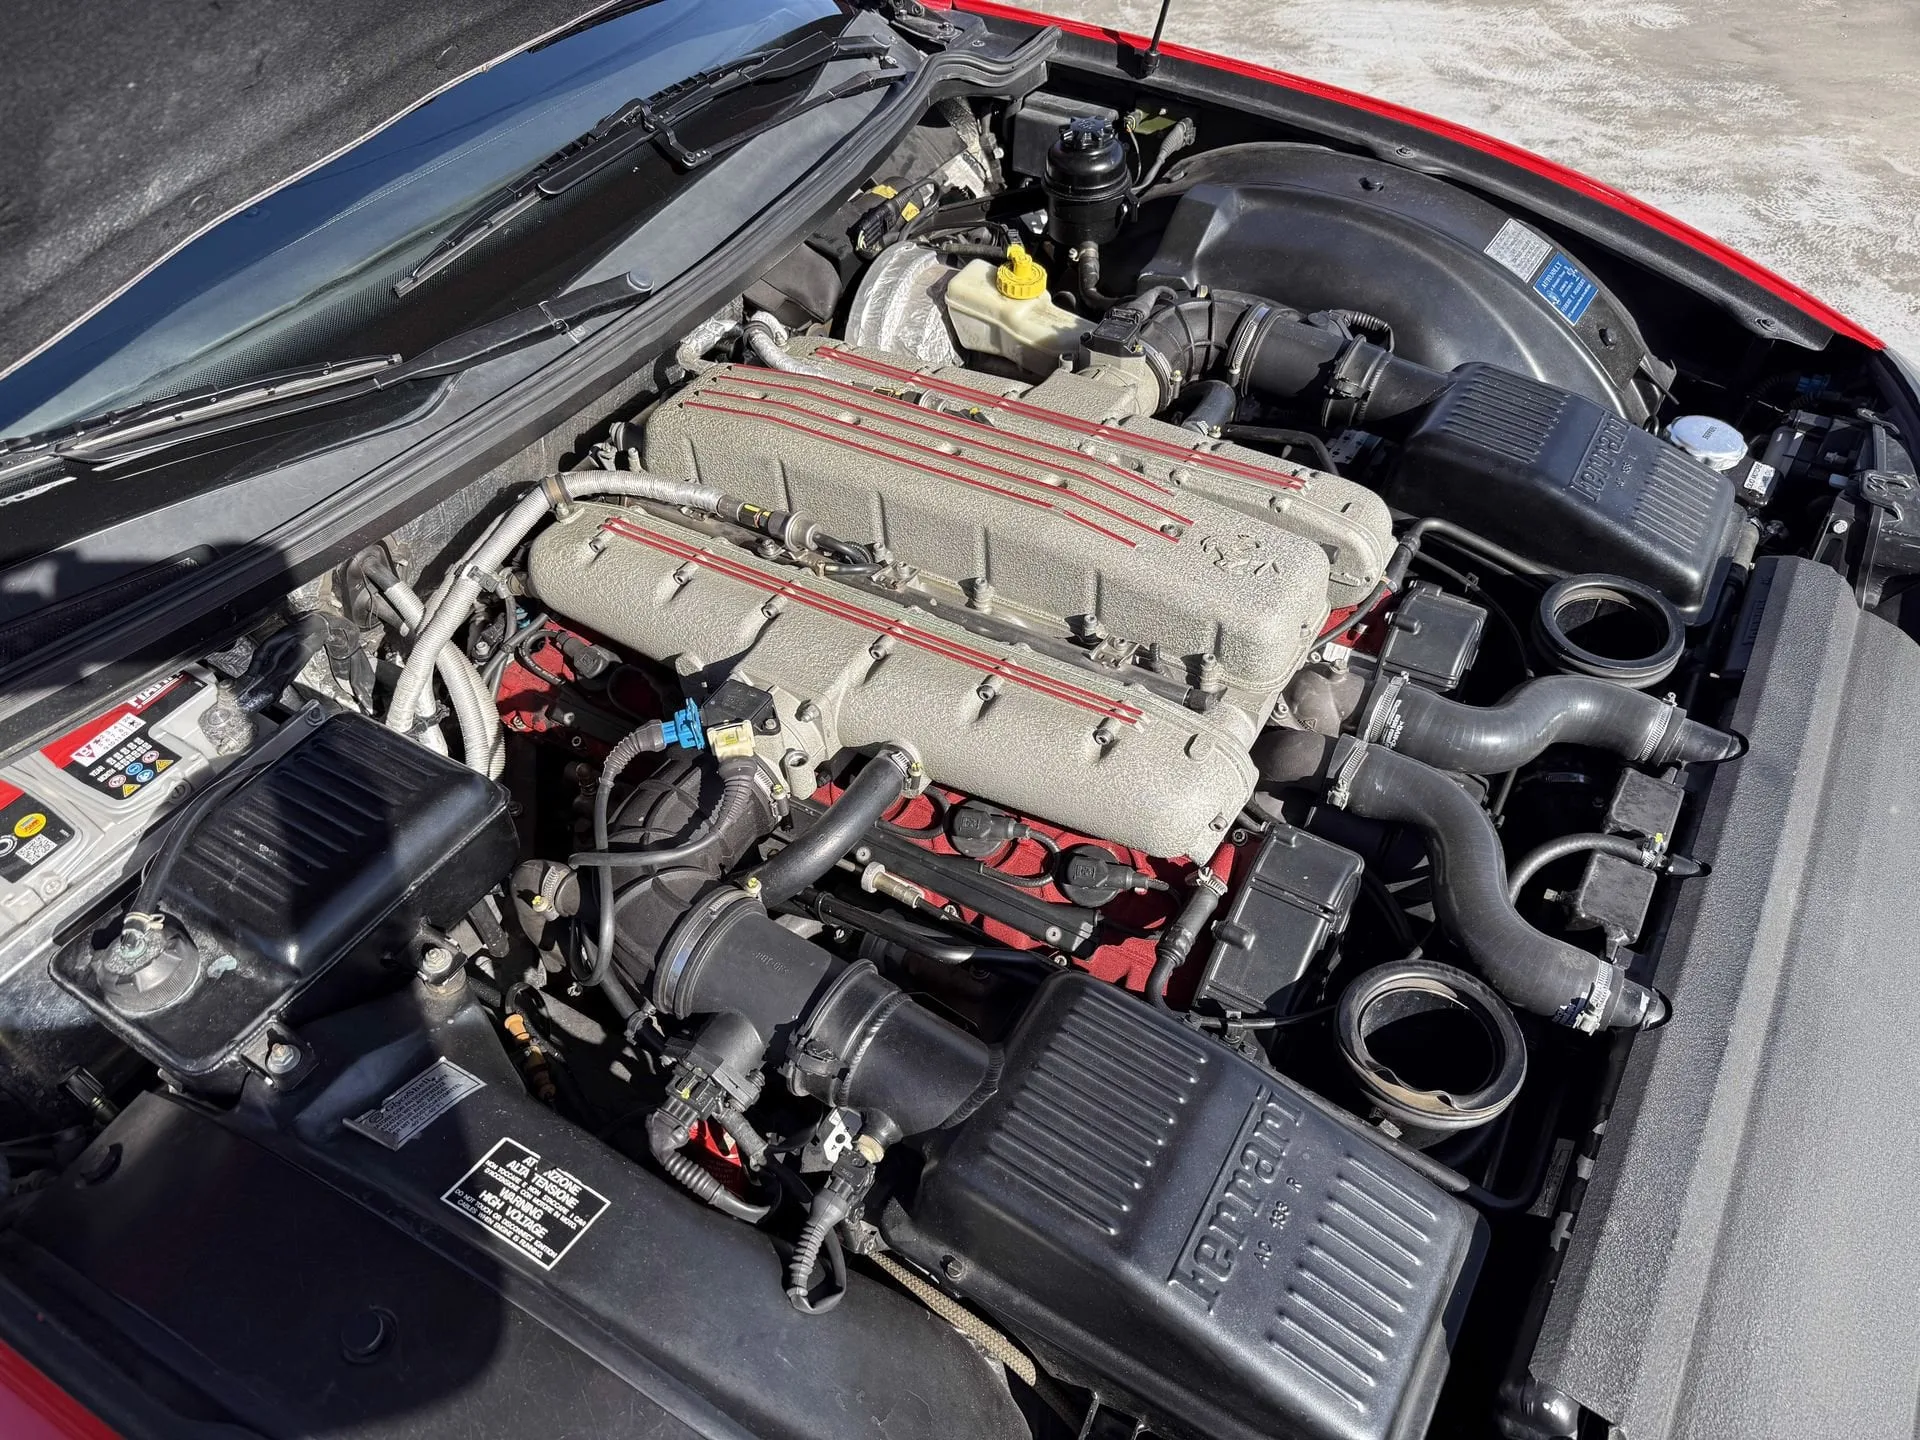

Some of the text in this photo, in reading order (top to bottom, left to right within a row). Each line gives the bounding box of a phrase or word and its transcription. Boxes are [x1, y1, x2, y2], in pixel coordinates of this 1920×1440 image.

[88, 764, 106, 777] YEAR
[484, 1159, 498, 1169] NON
[496, 1167, 521, 1184] TOCCARE
[527, 1185, 541, 1196] NON
[541, 1195, 569, 1214] STACCARE
[484, 1167, 520, 1191] D'ACCENSIONE
[519, 1189, 533, 1199] CON
[532, 1198, 554, 1213] MOTORE
[506, 1159, 579, 1208] ALTA TENSIONE
[522, 1155, 582, 1196] ATNZIONE
[1286, 1177, 1303, 1193] R
[454, 1188, 464, 1196] DO
[463, 1194, 475, 1202] NOT
[474, 1201, 492, 1214] TOUCH
[501, 1219, 533, 1242] DISCONNECT
[533, 1240, 557, 1257] IGNITION
[456, 1198, 477, 1213] CABLES
[477, 1212, 494, 1224] WHEN
[492, 1222, 513, 1237] ENGINE
[478, 1190, 548, 1238] HIGH VOLTAGE
[497, 1187, 544, 1220] WARNING
[1167, 1084, 1306, 1316] Ferrari
